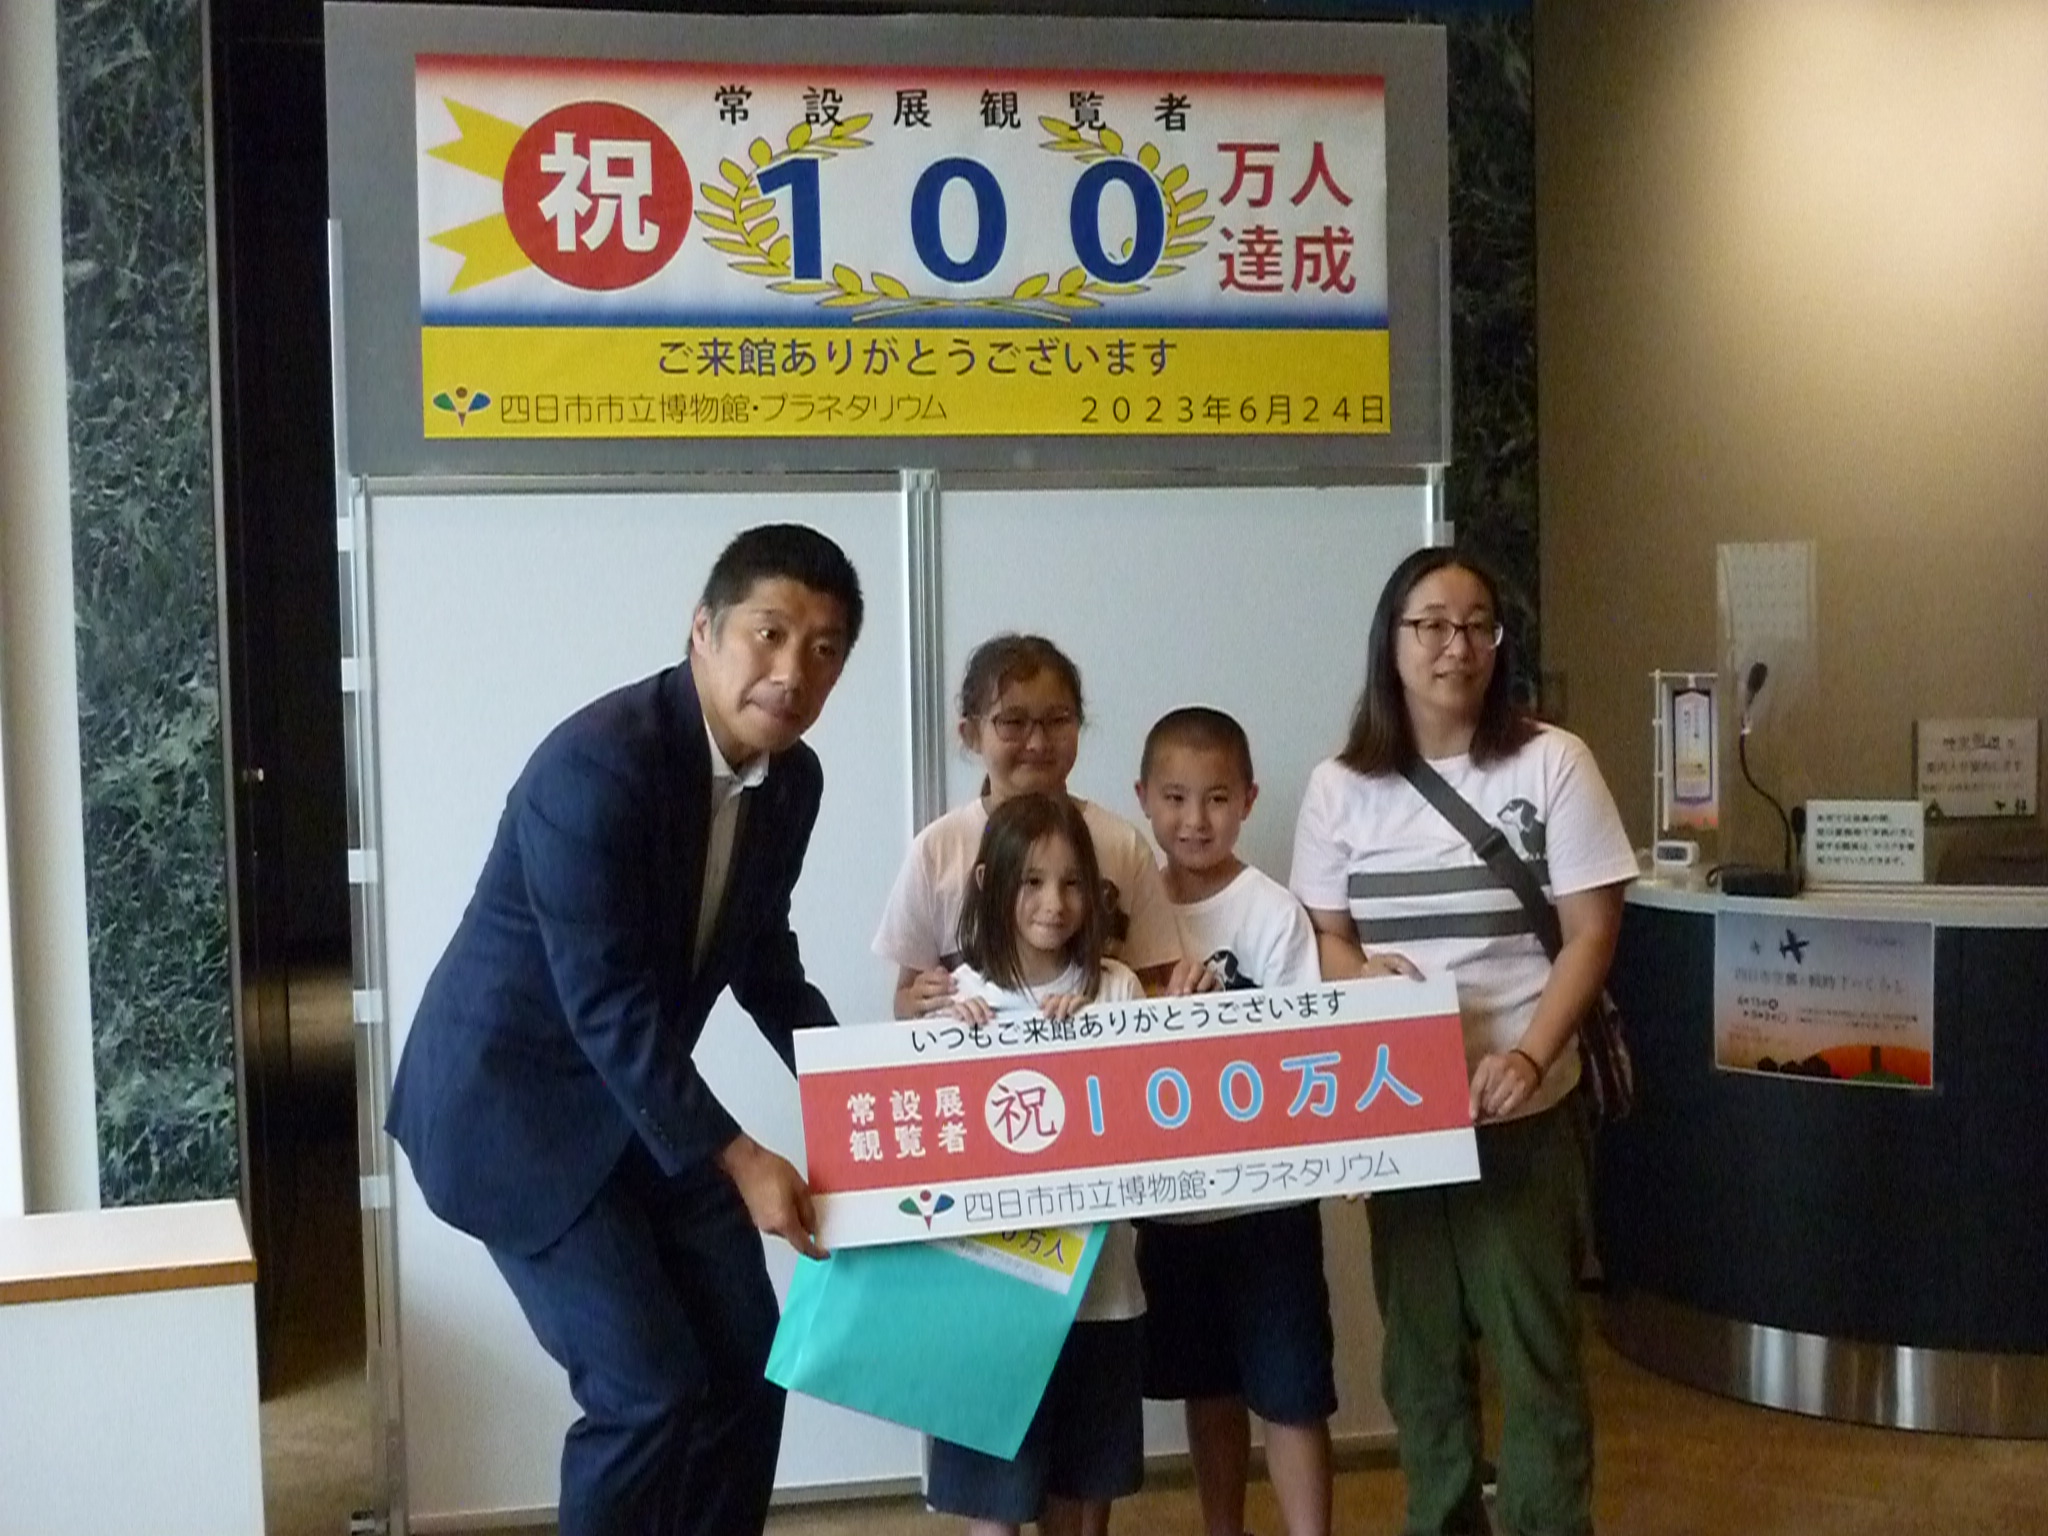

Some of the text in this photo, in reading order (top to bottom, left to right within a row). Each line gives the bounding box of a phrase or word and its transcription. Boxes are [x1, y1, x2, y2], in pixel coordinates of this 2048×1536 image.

[714, 84, 1192, 132] 常設展観覧者
[537, 131, 661, 252] 祝
[1217, 141, 1354, 209] 万人
[757, 156, 1167, 285] 100
[1217, 224, 1357, 295] 達成
[657, 336, 1178, 378] ご来館ありがとうございます
[1080, 393, 1386, 426] 2023年6月24日
[910, 988, 1347, 1053] いつもご来館ありがとうございます
[846, 1084, 966, 1126] 常設展
[990, 1082, 1058, 1146] 祝
[1085, 1043, 1424, 1137] 100万人
[849, 1119, 968, 1163] 観覧者
